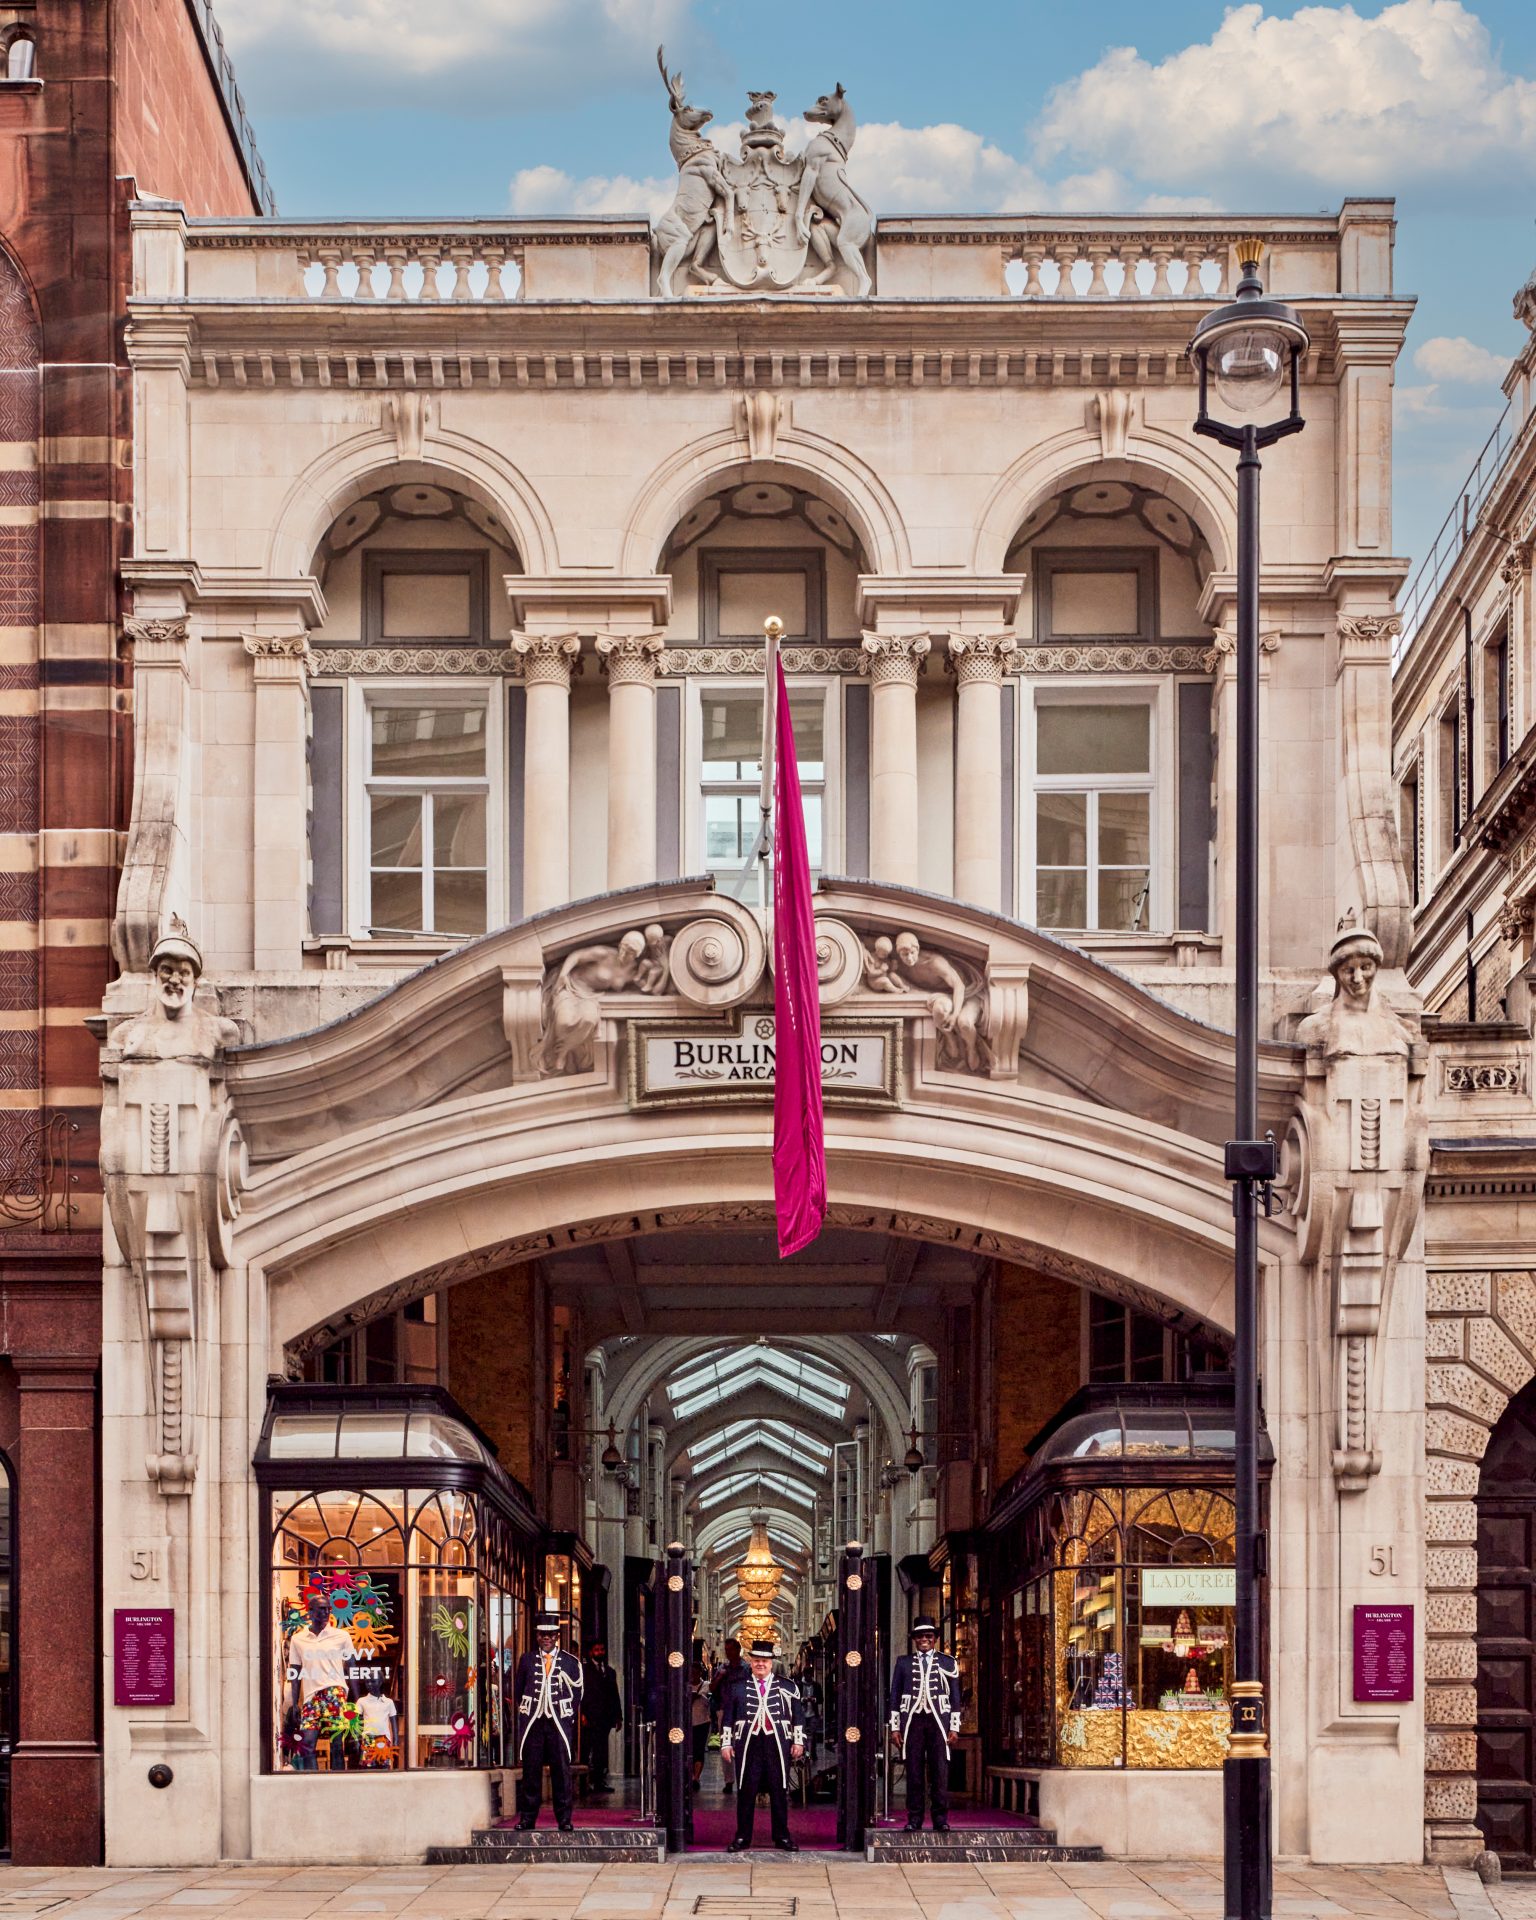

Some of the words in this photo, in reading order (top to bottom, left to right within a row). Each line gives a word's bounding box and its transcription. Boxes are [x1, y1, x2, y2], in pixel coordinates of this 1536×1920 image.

[674, 1041, 859, 1067] BURLINON
[728, 1066, 776, 1080] ARCA
[130, 1549, 160, 1581] 51
[1369, 1544, 1399, 1577] 51
[1151, 1572, 1236, 1588] LADURÉE
